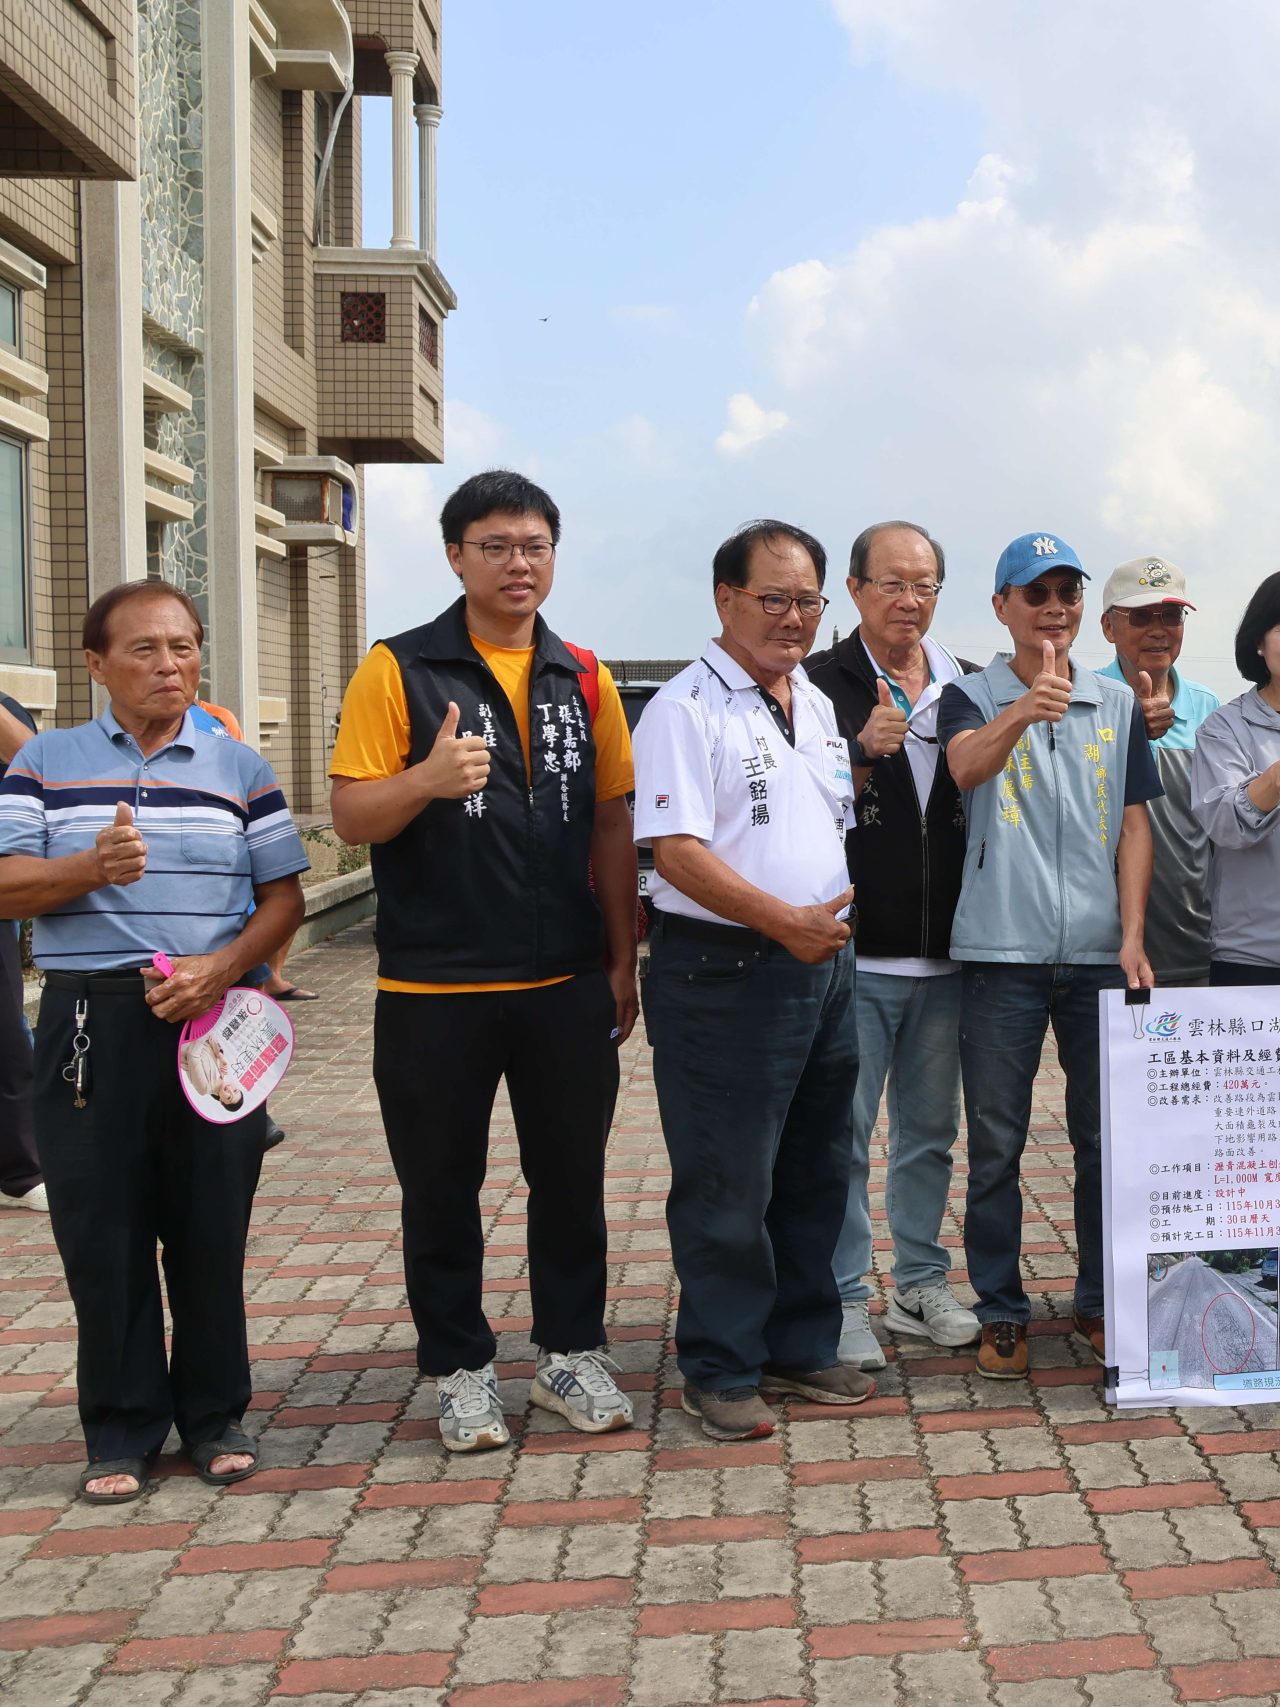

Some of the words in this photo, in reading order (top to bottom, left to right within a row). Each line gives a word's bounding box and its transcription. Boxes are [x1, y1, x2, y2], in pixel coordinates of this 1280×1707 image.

[478, 703, 497, 747] 副主任
[536, 703, 562, 773] 丁學忠
[558, 704, 582, 773] 張嘉郡
[826, 741, 843, 749] FILA
[754, 736, 777, 771] 村長
[742, 756, 770, 827] 王銘揚
